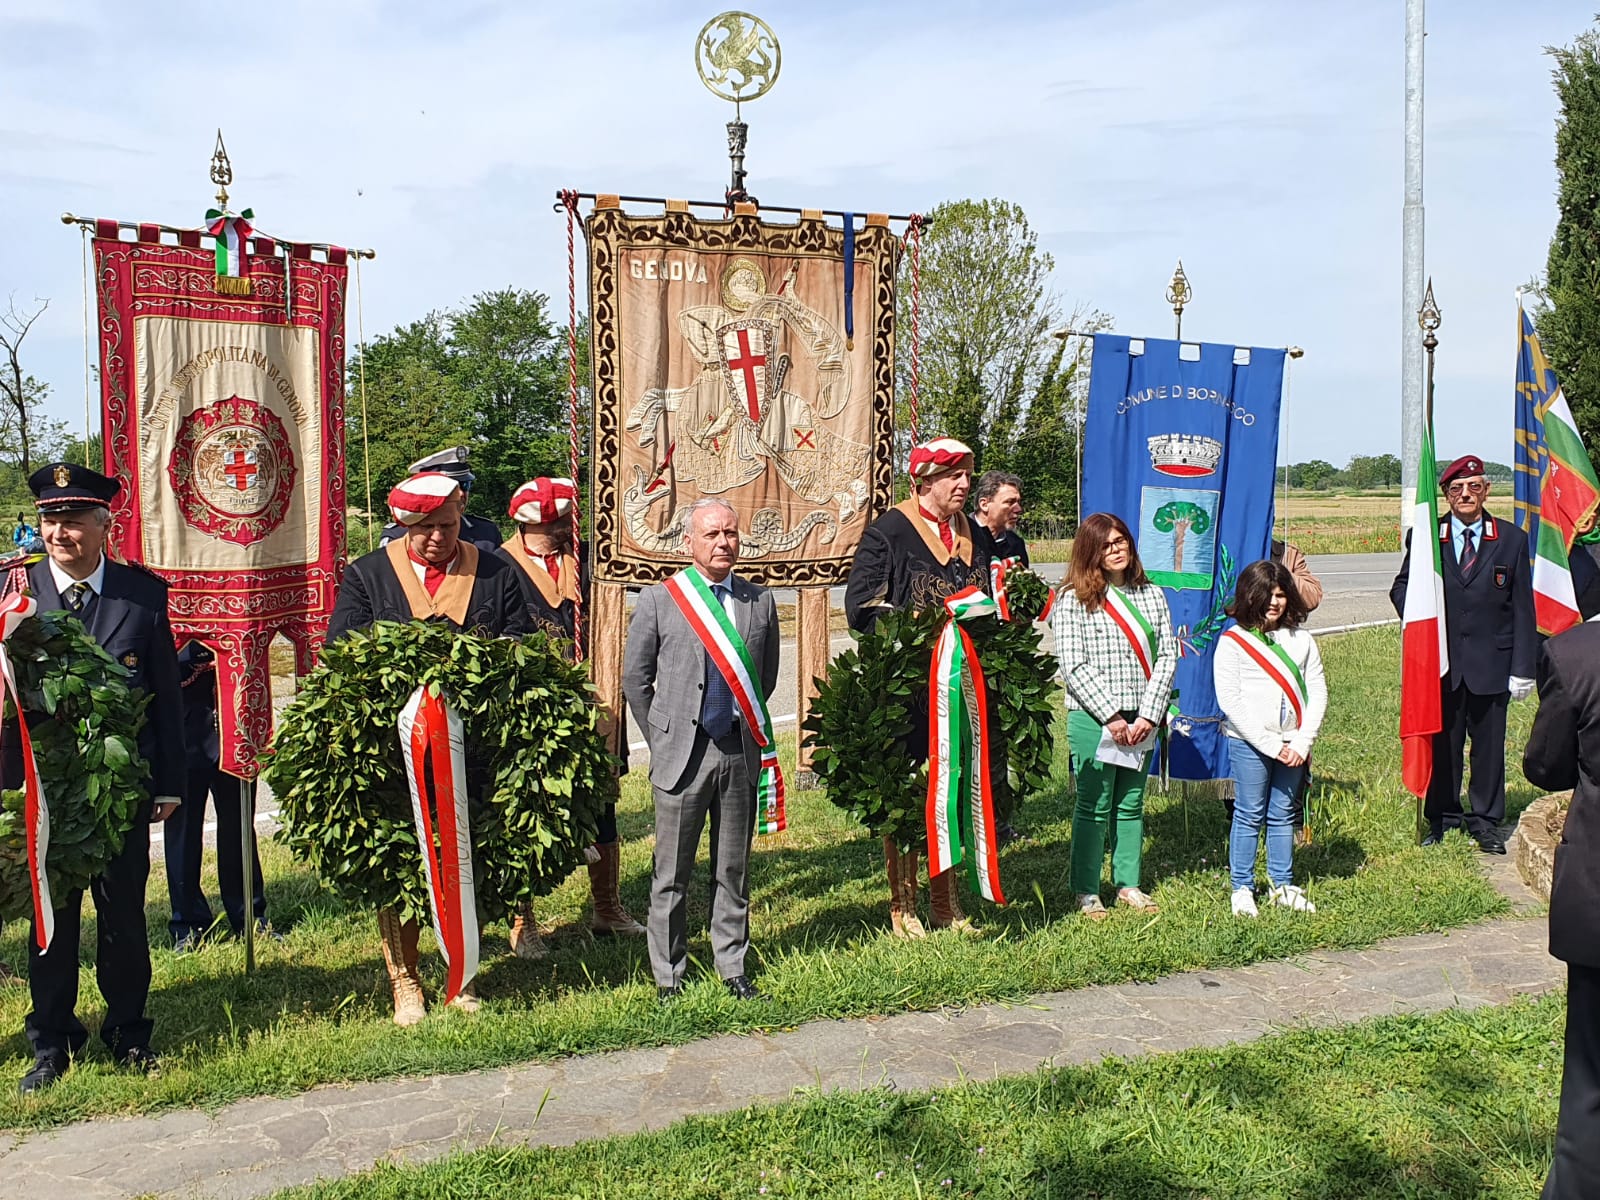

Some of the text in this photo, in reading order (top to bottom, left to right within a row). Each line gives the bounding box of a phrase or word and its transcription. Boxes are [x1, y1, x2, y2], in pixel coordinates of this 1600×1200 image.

[630, 260, 708, 284] GENOVA
[266, 363, 281, 383] DI
[276, 377, 308, 427] GENOVA
[1116, 386, 1168, 414] COMUNE
